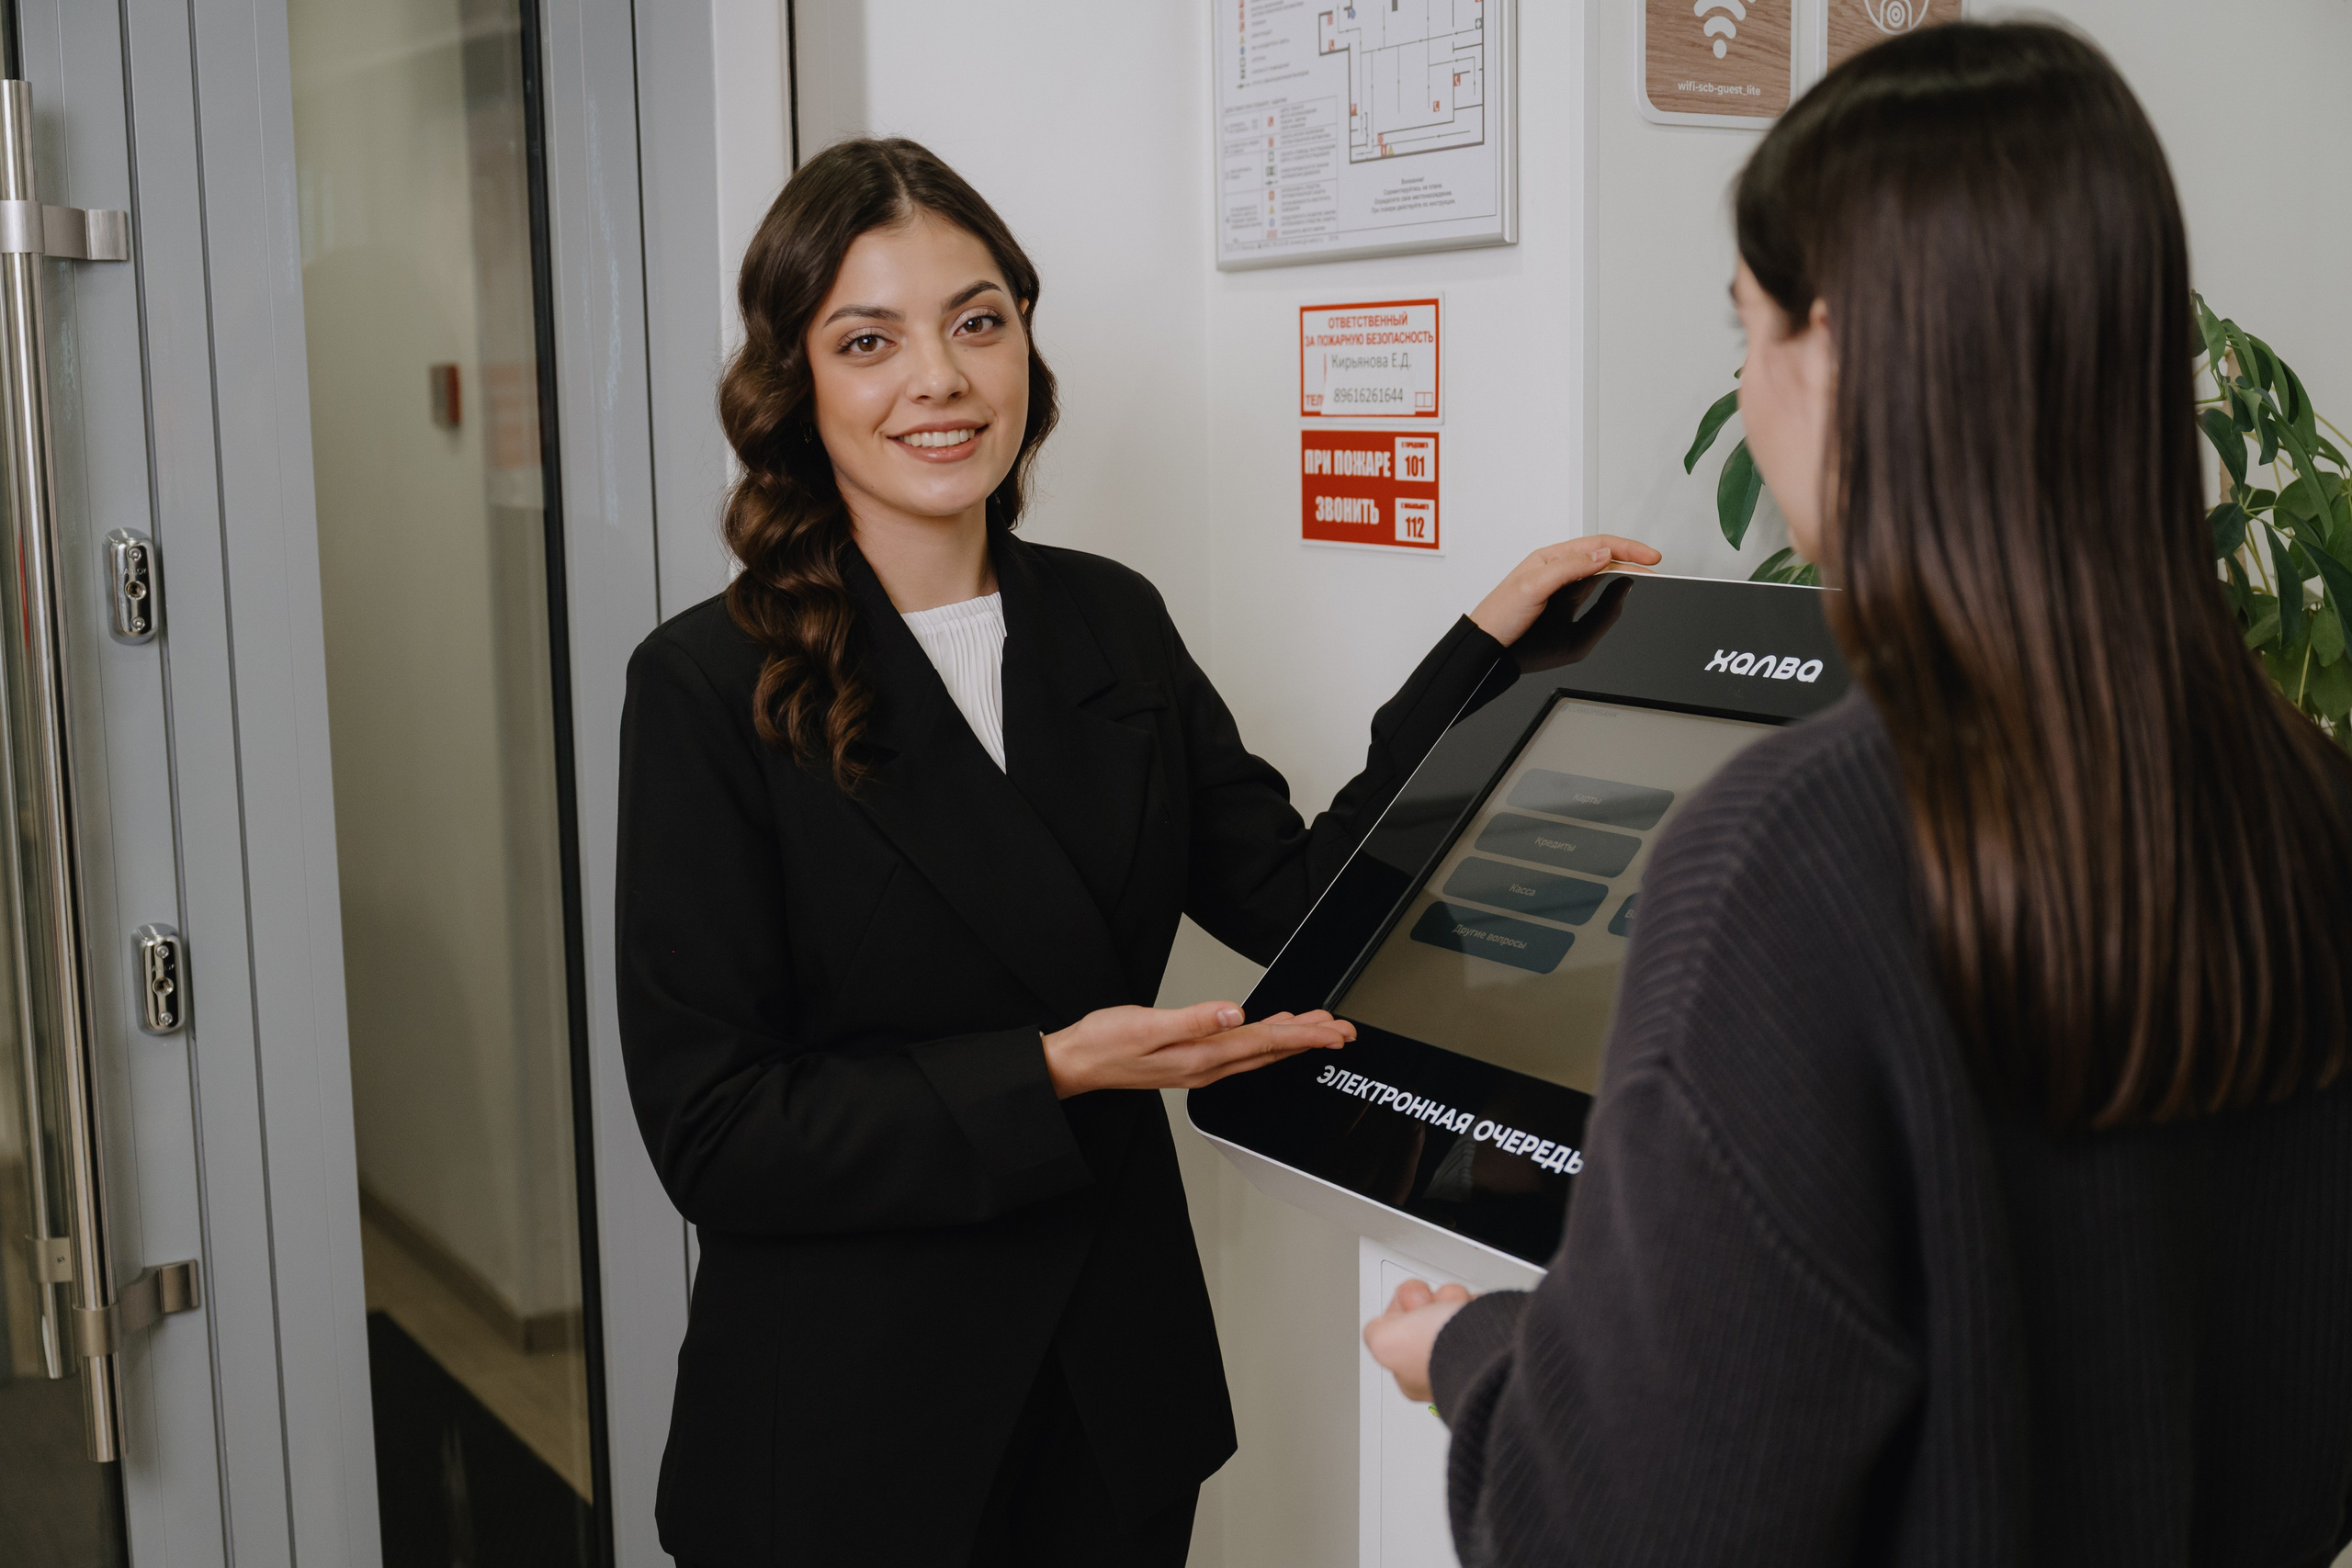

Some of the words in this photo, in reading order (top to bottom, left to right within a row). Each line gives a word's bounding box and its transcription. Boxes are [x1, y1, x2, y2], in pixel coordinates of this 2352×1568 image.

[1678, 81, 1761, 96] wifi-scb-guest_lite
[1328, 311, 1408, 329] ОТВЕТСТВЕННЫЙ
[1306, 335, 1315, 347] ЗА
[1317, 333, 1364, 346] ПОЖАРНУЮ
[1366, 331, 1434, 345] БЕЗОПАСНОСТЬ
[1331, 355, 1388, 371] Кирьянова
[1392, 353, 1412, 370] Е.Д.
[1333, 388, 1404, 402] 89616261644
[1305, 449, 1331, 475] ПРИ
[1334, 450, 1391, 478] ПОЖАРЕ
[1406, 455, 1425, 477] 101
[1316, 496, 1380, 525] ЗВОНИТЬ
[1406, 516, 1425, 538] 112
[1573, 793, 1602, 805] Карты
[1534, 837, 1576, 852] Кредиты
[1510, 884, 1536, 897] Касса
[1452, 924, 1487, 940] Другие
[1487, 933, 1528, 950] вопросы
[1317, 1065, 1475, 1135] ЭЛЕКТРОННАЯ
[1472, 1120, 1585, 1175] ОЧЕРЕДЬ
